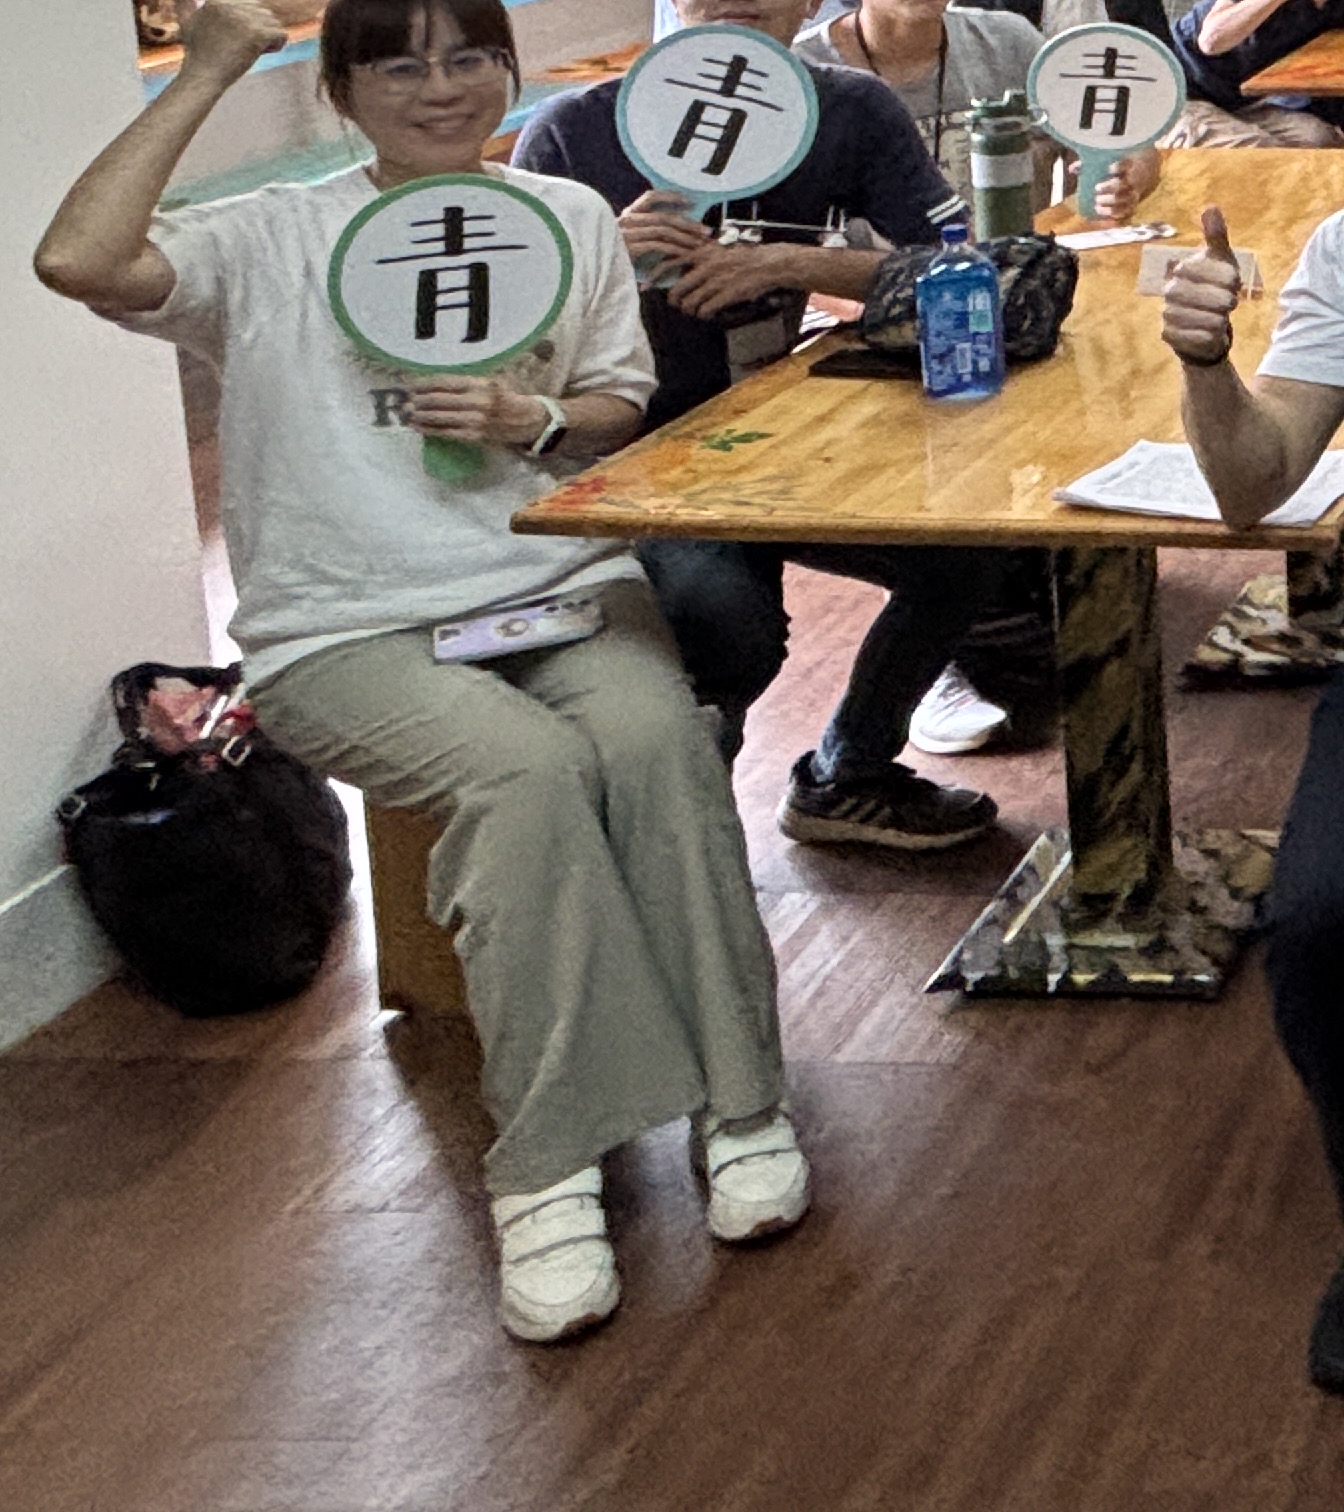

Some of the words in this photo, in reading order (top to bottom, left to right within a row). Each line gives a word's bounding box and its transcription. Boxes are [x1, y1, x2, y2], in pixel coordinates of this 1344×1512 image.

[664, 54, 784, 176] 青
[1059, 46, 1158, 137] 青
[376, 205, 529, 345] 青
